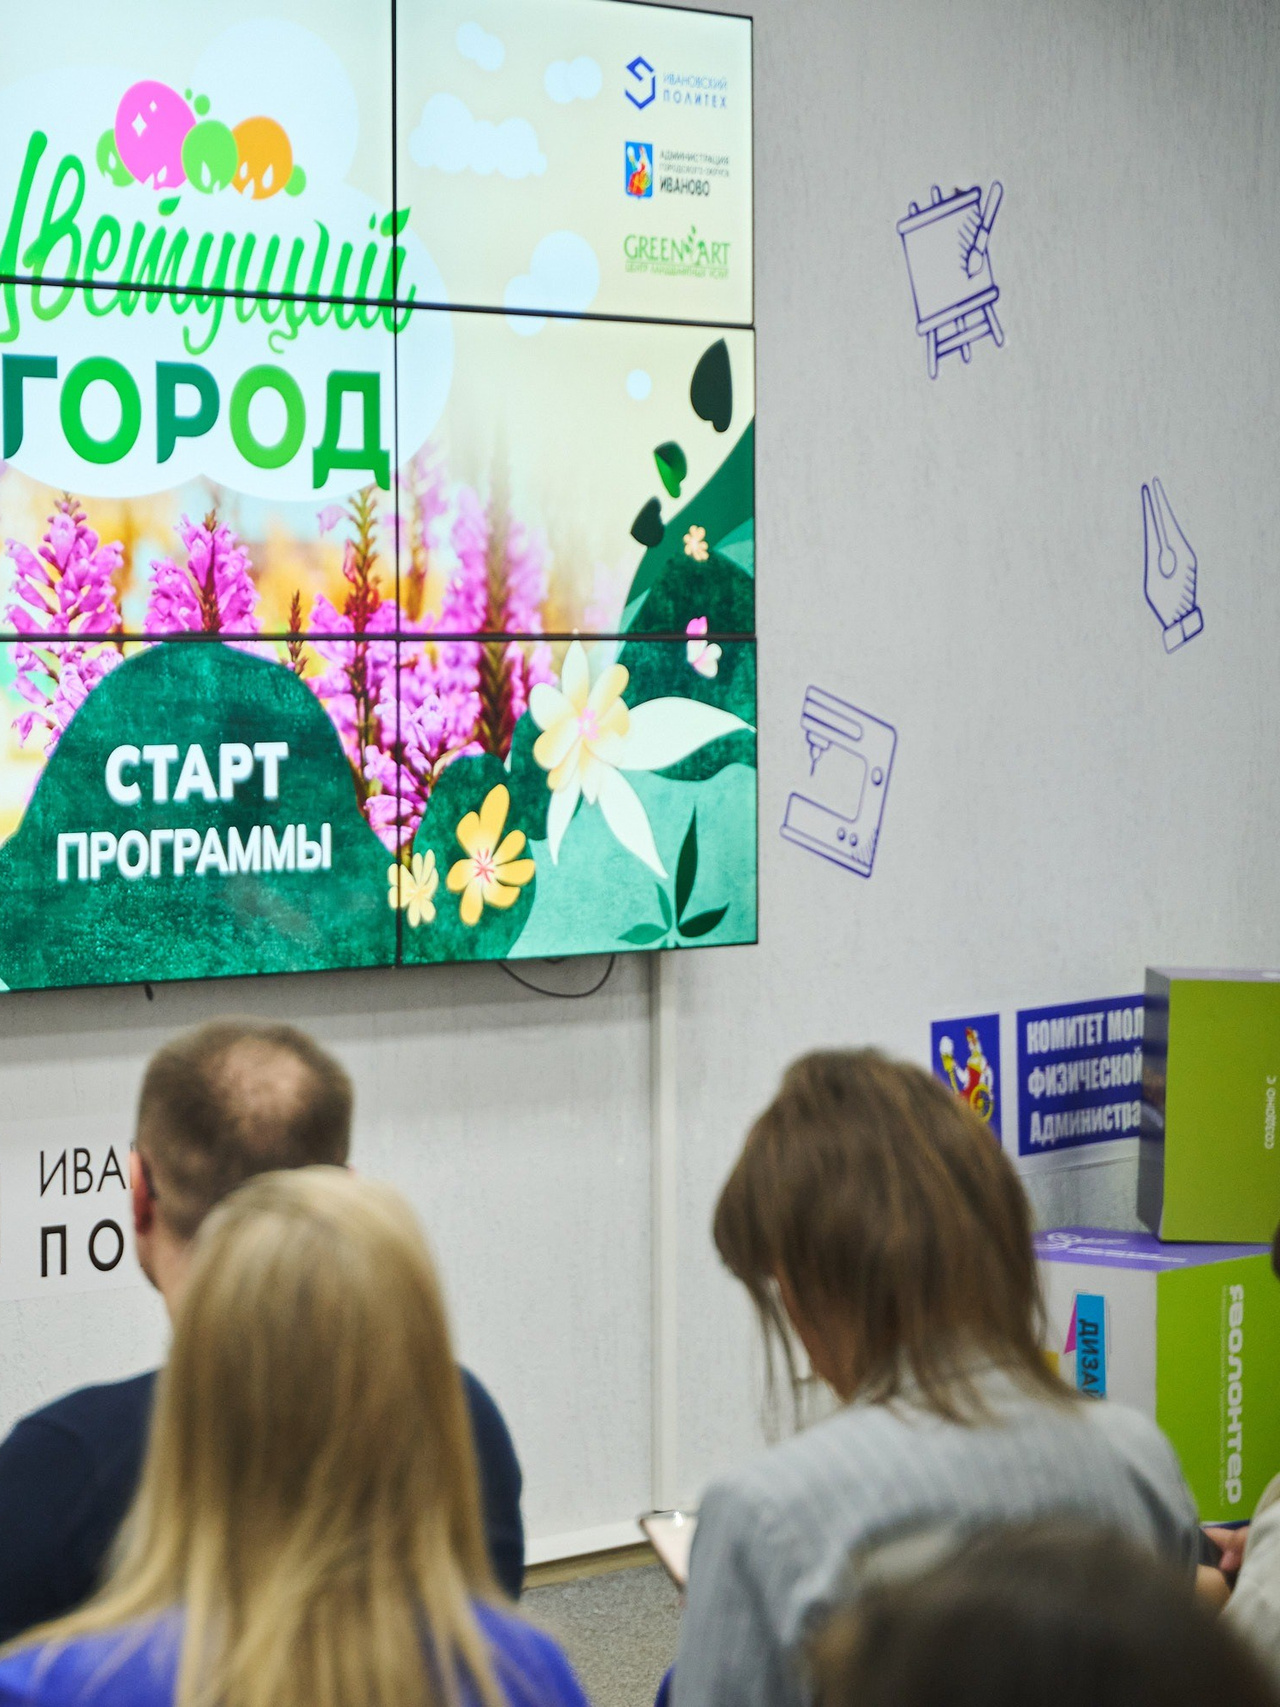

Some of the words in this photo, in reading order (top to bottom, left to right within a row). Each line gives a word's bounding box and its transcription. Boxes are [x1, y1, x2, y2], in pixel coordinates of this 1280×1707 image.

[663, 73, 728, 91] ИВАНОВСКИЙ
[663, 89, 728, 109] ПОЛИТЕХ
[660, 176, 710, 196] ИВАНОВО
[2, 353, 391, 491] ГОРОД
[105, 741, 289, 806] СТАРТ
[57, 822, 332, 882] ПРОГРАММЫ
[1027, 1012, 1105, 1054] КОМИТЕТ
[1028, 1046, 1143, 1099] ФИЗИЧЕСКОЙ
[40, 1145, 126, 1197] ИВА
